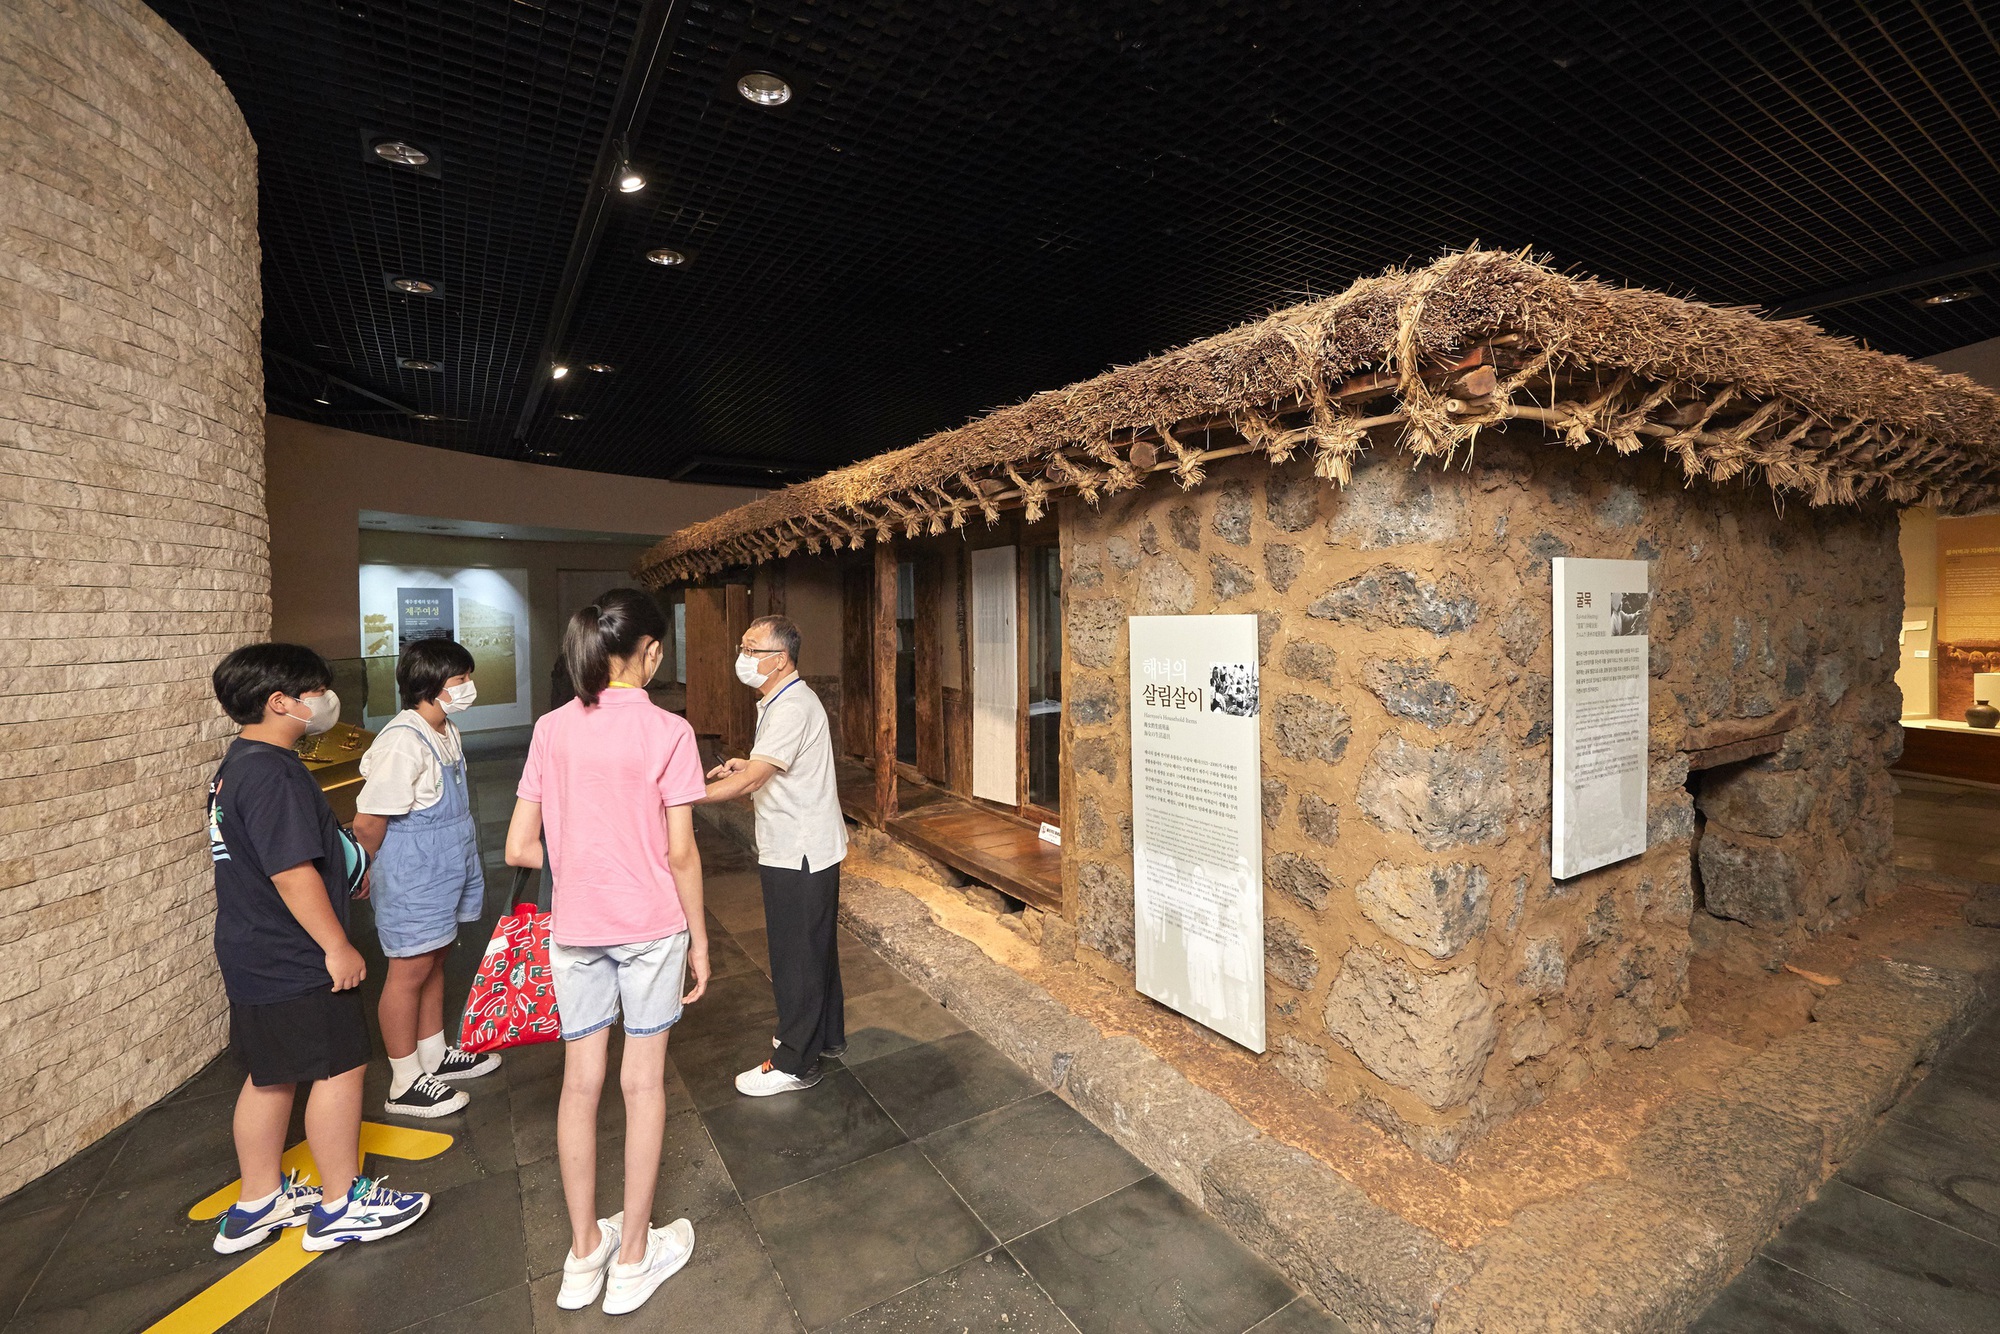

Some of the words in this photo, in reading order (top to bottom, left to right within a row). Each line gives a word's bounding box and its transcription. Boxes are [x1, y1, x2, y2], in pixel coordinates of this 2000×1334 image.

[1576, 592, 1592, 608] 굴묵
[405, 607, 439, 616] 제주여성
[1142, 658, 1187, 683] 해녀의
[1142, 683, 1203, 712] 살림살이
